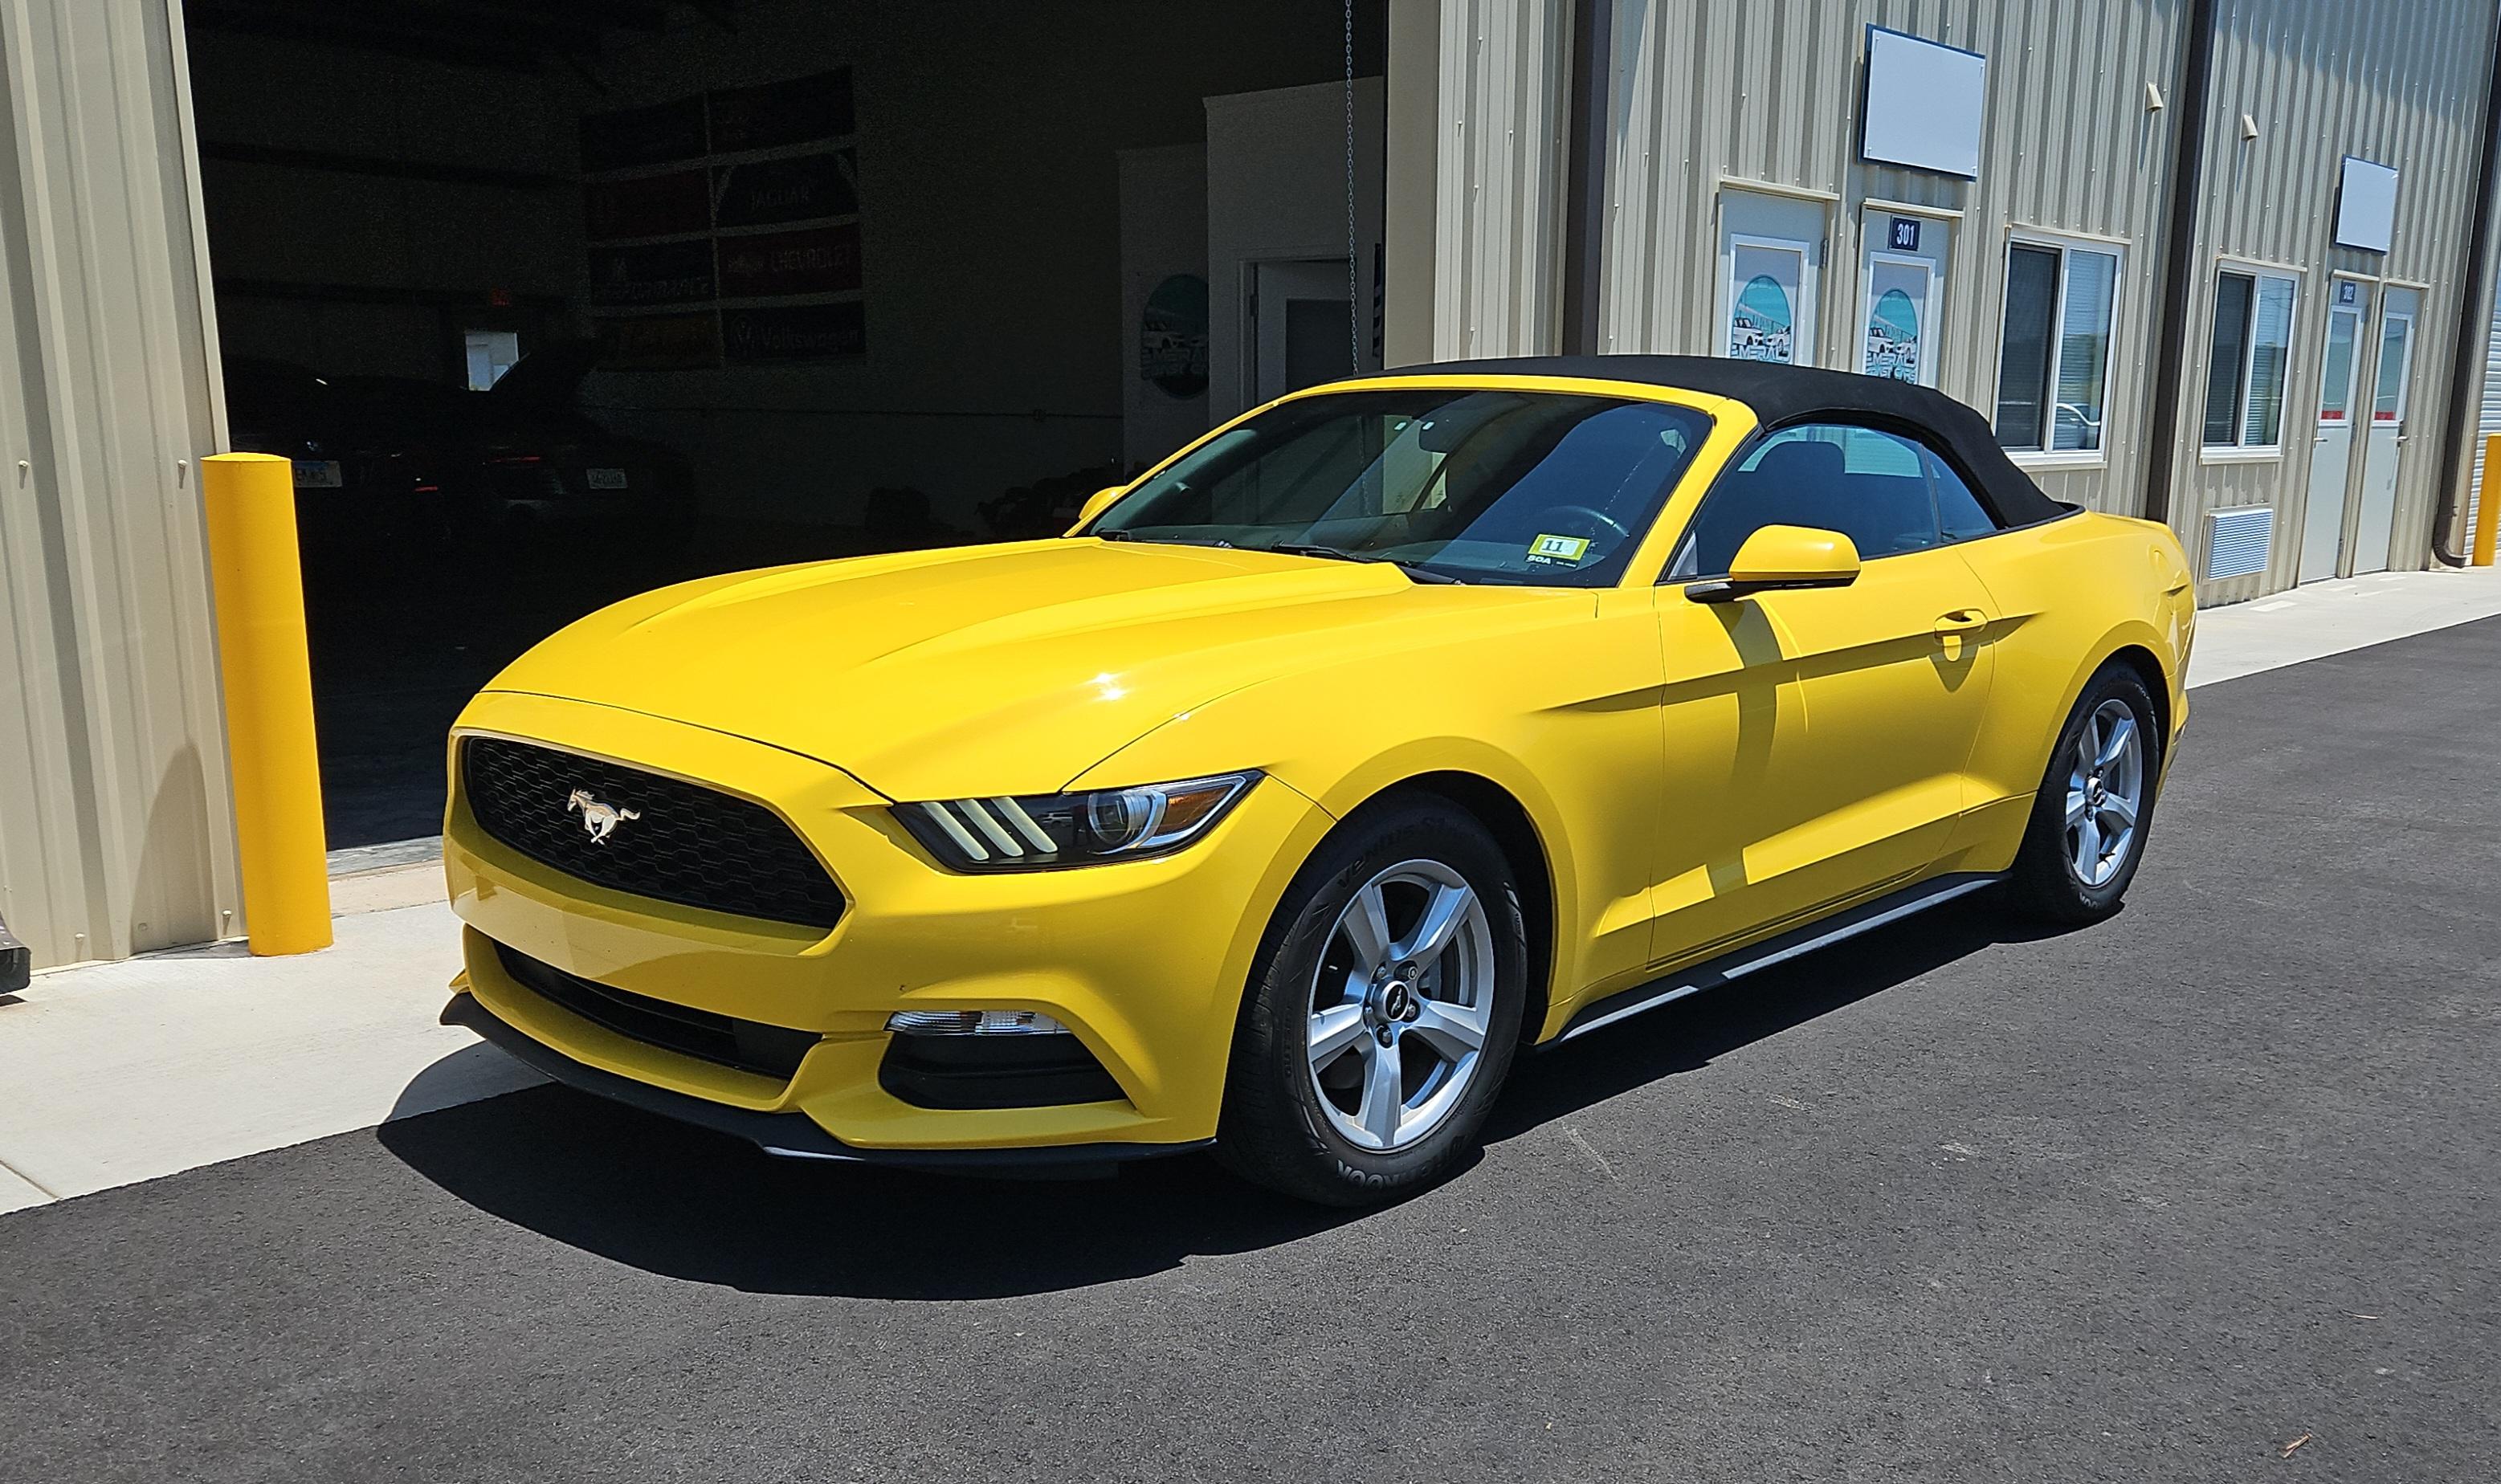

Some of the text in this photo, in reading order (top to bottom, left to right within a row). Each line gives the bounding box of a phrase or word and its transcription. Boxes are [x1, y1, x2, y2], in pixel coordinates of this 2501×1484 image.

[1896, 222, 1916, 247] 301
[769, 244, 851, 273] CHEVROLET
[760, 326, 859, 353] Volkswagen
[1141, 347, 1207, 365] EMERA
[1731, 344, 1791, 362] EMERALD
[1866, 351, 1917, 369] EMERALD
